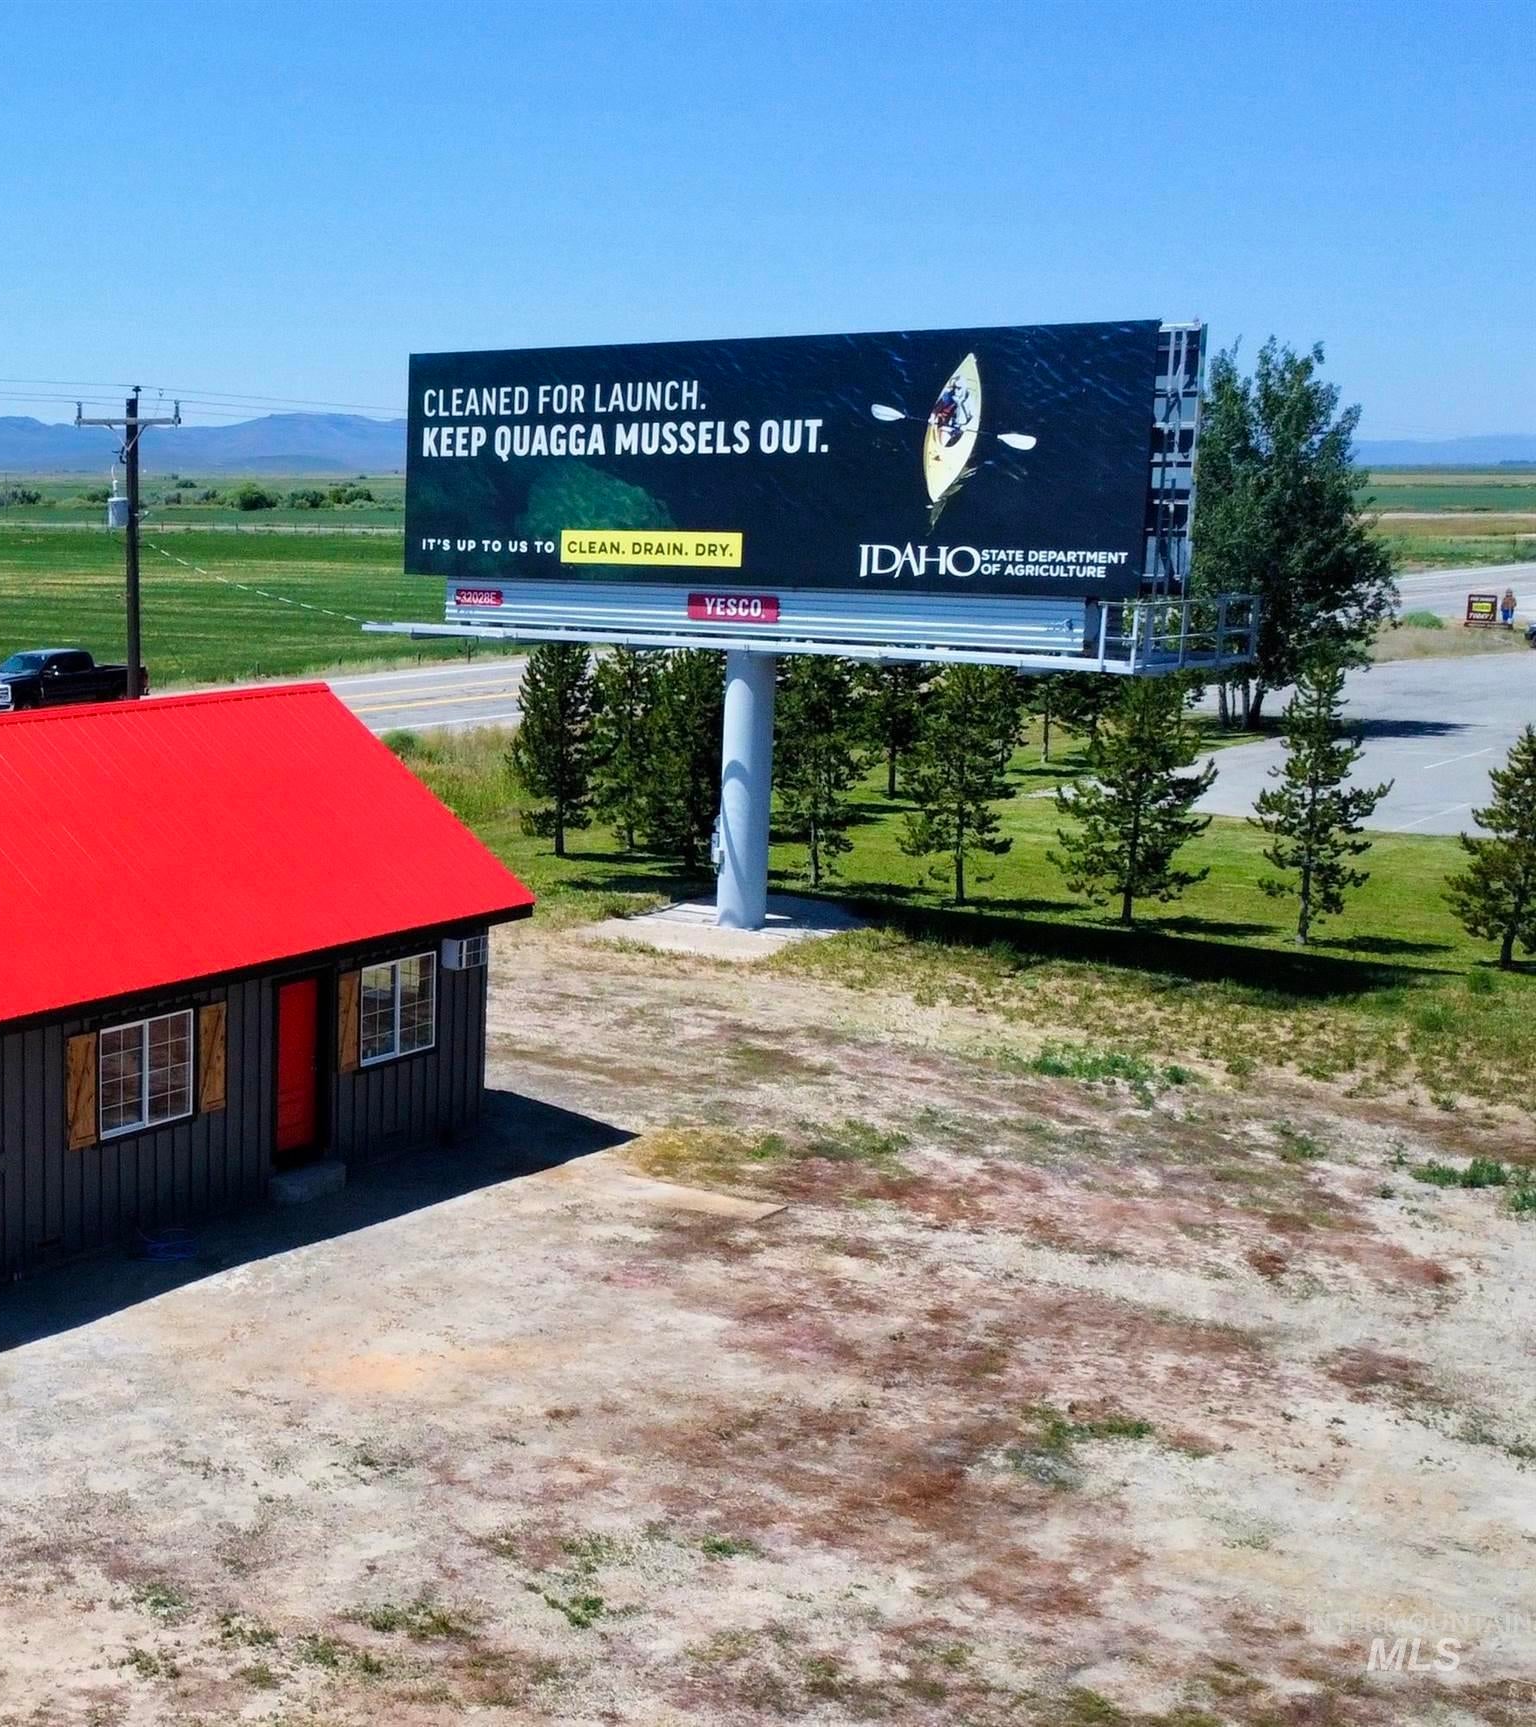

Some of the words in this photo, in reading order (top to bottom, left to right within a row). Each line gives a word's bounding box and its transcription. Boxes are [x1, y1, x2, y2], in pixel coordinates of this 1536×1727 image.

[423, 386, 529, 418] CLEANED
[538, 384, 585, 415] FOR
[594, 380, 706, 413] LAUNCH.
[422, 426, 487, 457] KEEP
[494, 424, 606, 462] QUAGGA
[615, 420, 751, 456] MUSSELS
[759, 419, 829, 454] OUT.
[422, 538, 451, 551] IT'S
[456, 539, 476, 552] UP
[481, 540, 502, 553] TO
[508, 540, 528, 554] US
[534, 541, 555, 554] TO
[567, 540, 626, 555] CLEAN.
[631, 542, 689, 556] DRAIN.
[695, 543, 734, 557] DRY.
[859, 541, 981, 579] IDAHO
[980, 549, 1024, 562] STATE
[1028, 550, 1128, 564] DEPARTMENT
[980, 563, 1000, 576] OF
[1004, 564, 1106, 578] AGRICULTURE
